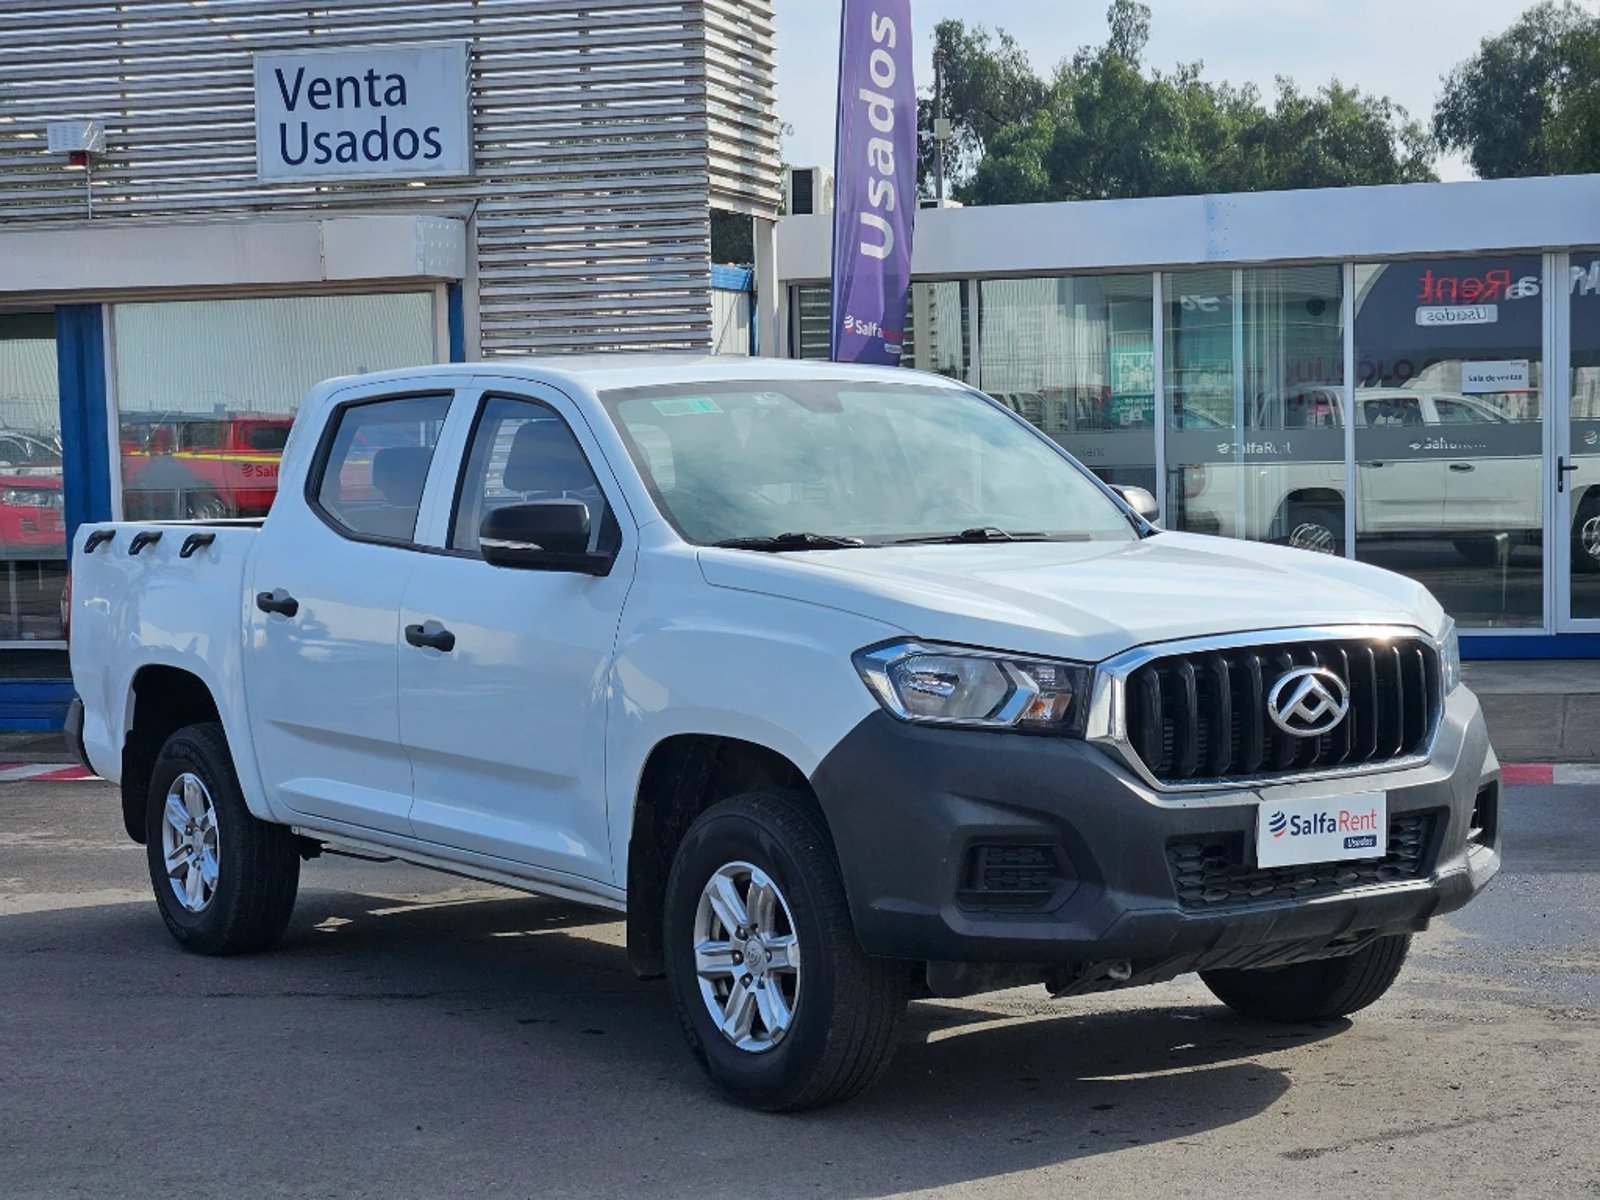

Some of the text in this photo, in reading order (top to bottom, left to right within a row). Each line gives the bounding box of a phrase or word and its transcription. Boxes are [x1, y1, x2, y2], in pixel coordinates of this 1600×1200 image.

[275, 67, 407, 112] Venta
[279, 115, 443, 166] Usados
[859, 11, 897, 260] Usados
[1290, 808, 1378, 836] SalfaRent
